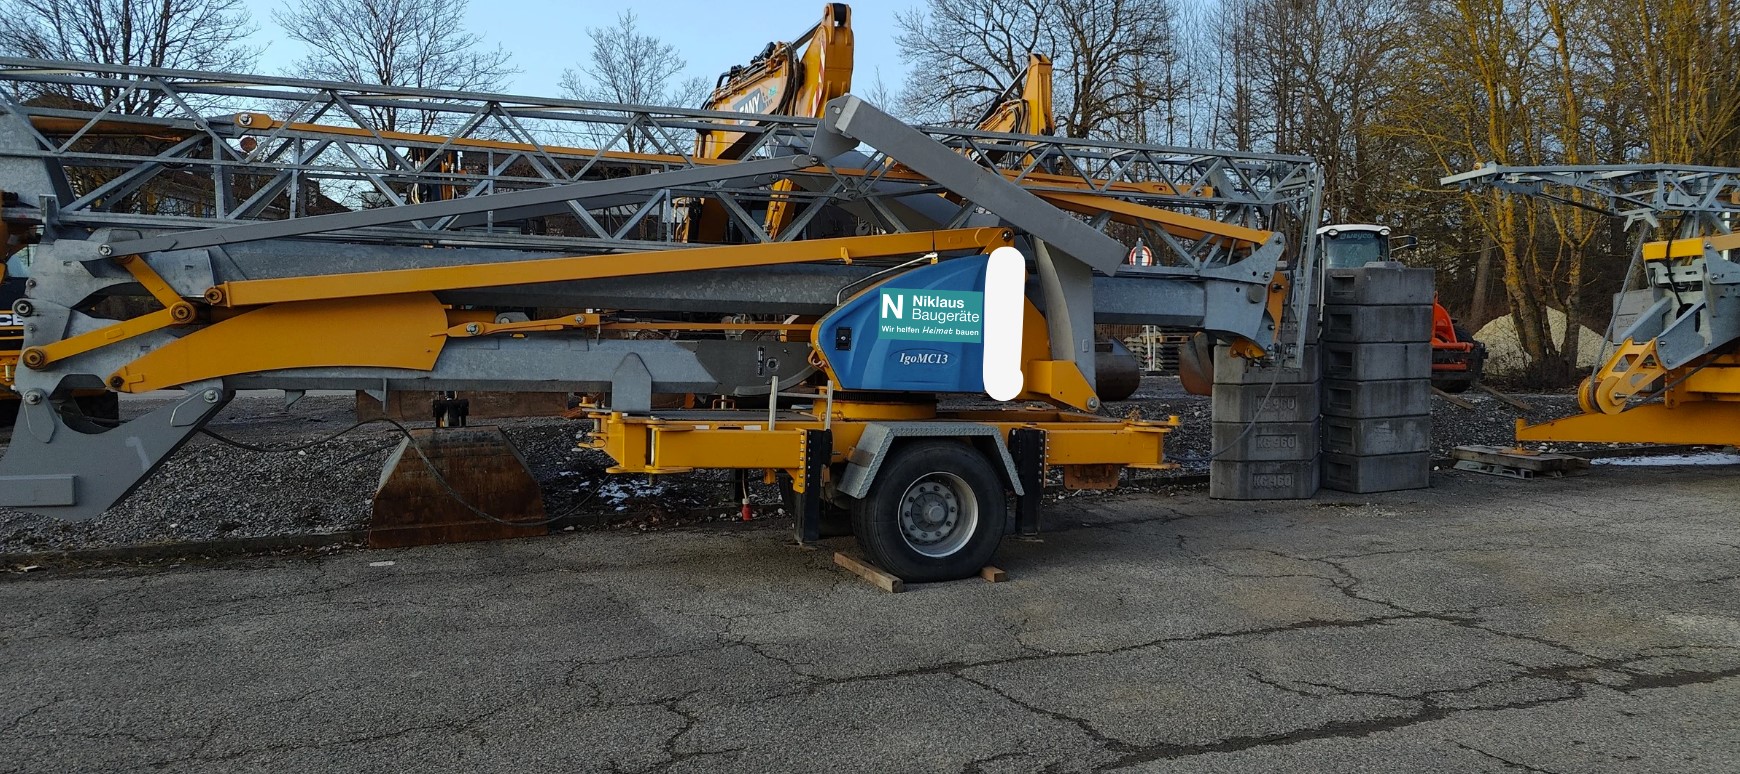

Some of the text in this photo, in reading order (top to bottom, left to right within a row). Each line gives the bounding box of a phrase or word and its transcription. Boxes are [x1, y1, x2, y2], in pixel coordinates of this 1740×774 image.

[882, 294, 903, 319] N
[913, 295, 964, 308] Niklaus
[912, 308, 979, 323] Baugeräte
[881, 325, 979, 336] Wir helfen Heimat bauen
[899, 353, 948, 365] IgoMC13
[1274, 437, 1295, 448] 960
